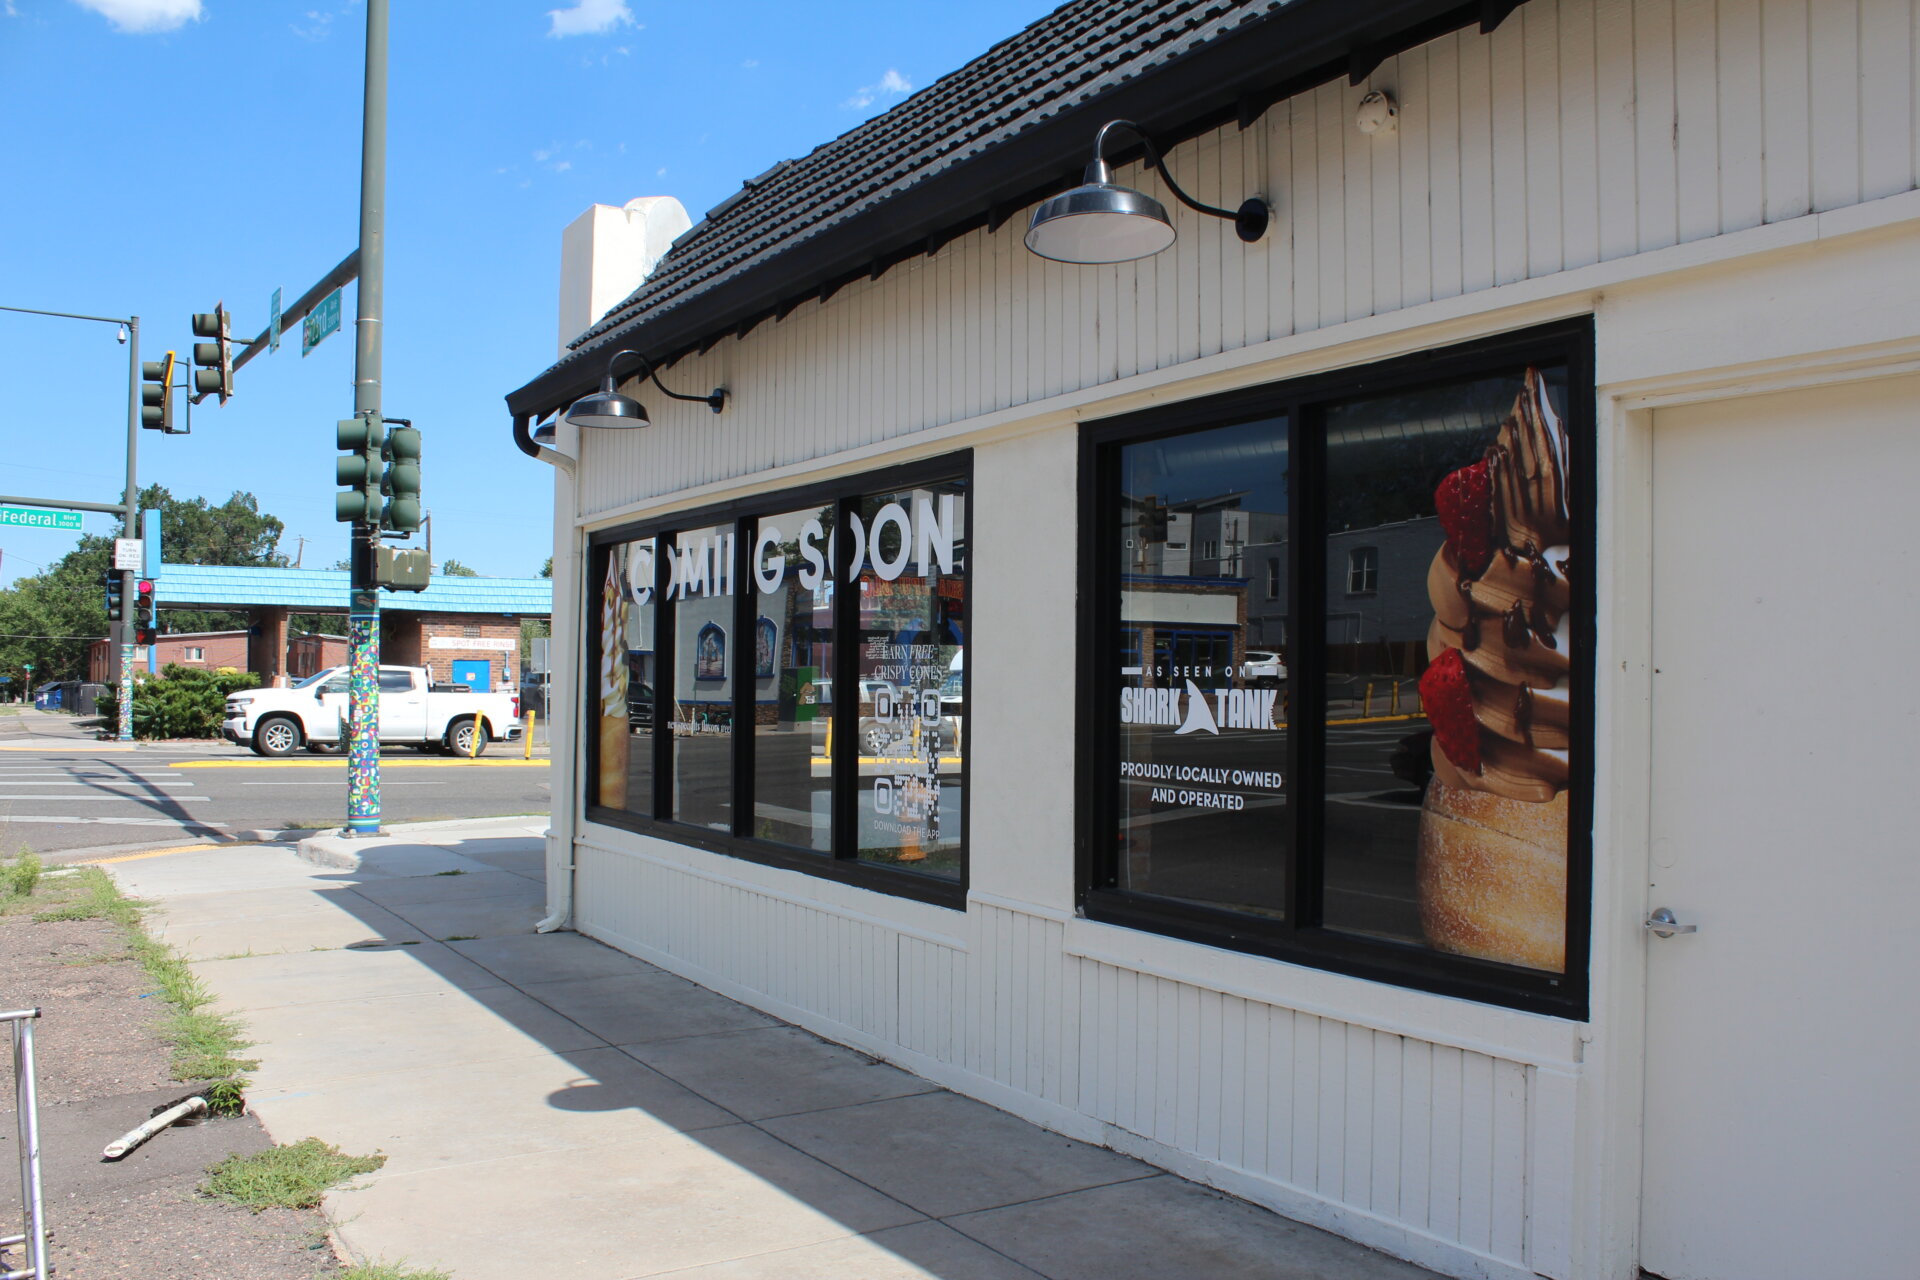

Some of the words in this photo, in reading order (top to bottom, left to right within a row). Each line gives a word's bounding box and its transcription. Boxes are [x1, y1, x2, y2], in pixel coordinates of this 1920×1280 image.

[2, 510, 57, 526] Federal
[451, 639, 470, 648] SPOT
[472, 640, 491, 648] FREE
[493, 640, 514, 649] RINSE
[882, 644, 908, 660] EARN
[909, 644, 935, 660] FREE
[874, 664, 908, 680] CRISPY
[909, 664, 943, 680] CONES
[1145, 665, 1163, 678] AS
[1173, 665, 1212, 678] SEEN
[1224, 666, 1246, 678] ON
[1121, 686, 1182, 726] SHARK
[1215, 688, 1278, 731] TANK
[1120, 762, 1174, 780] PROUDLY
[1175, 765, 1230, 785] LOCALLY
[1232, 769, 1282, 789] OWNED
[1151, 787, 1176, 804] AND
[1178, 790, 1244, 811] OPERATED
[874, 819, 912, 836] DOWNLOAD
[912, 826, 926, 838] THE
[926, 829, 940, 841] APP
